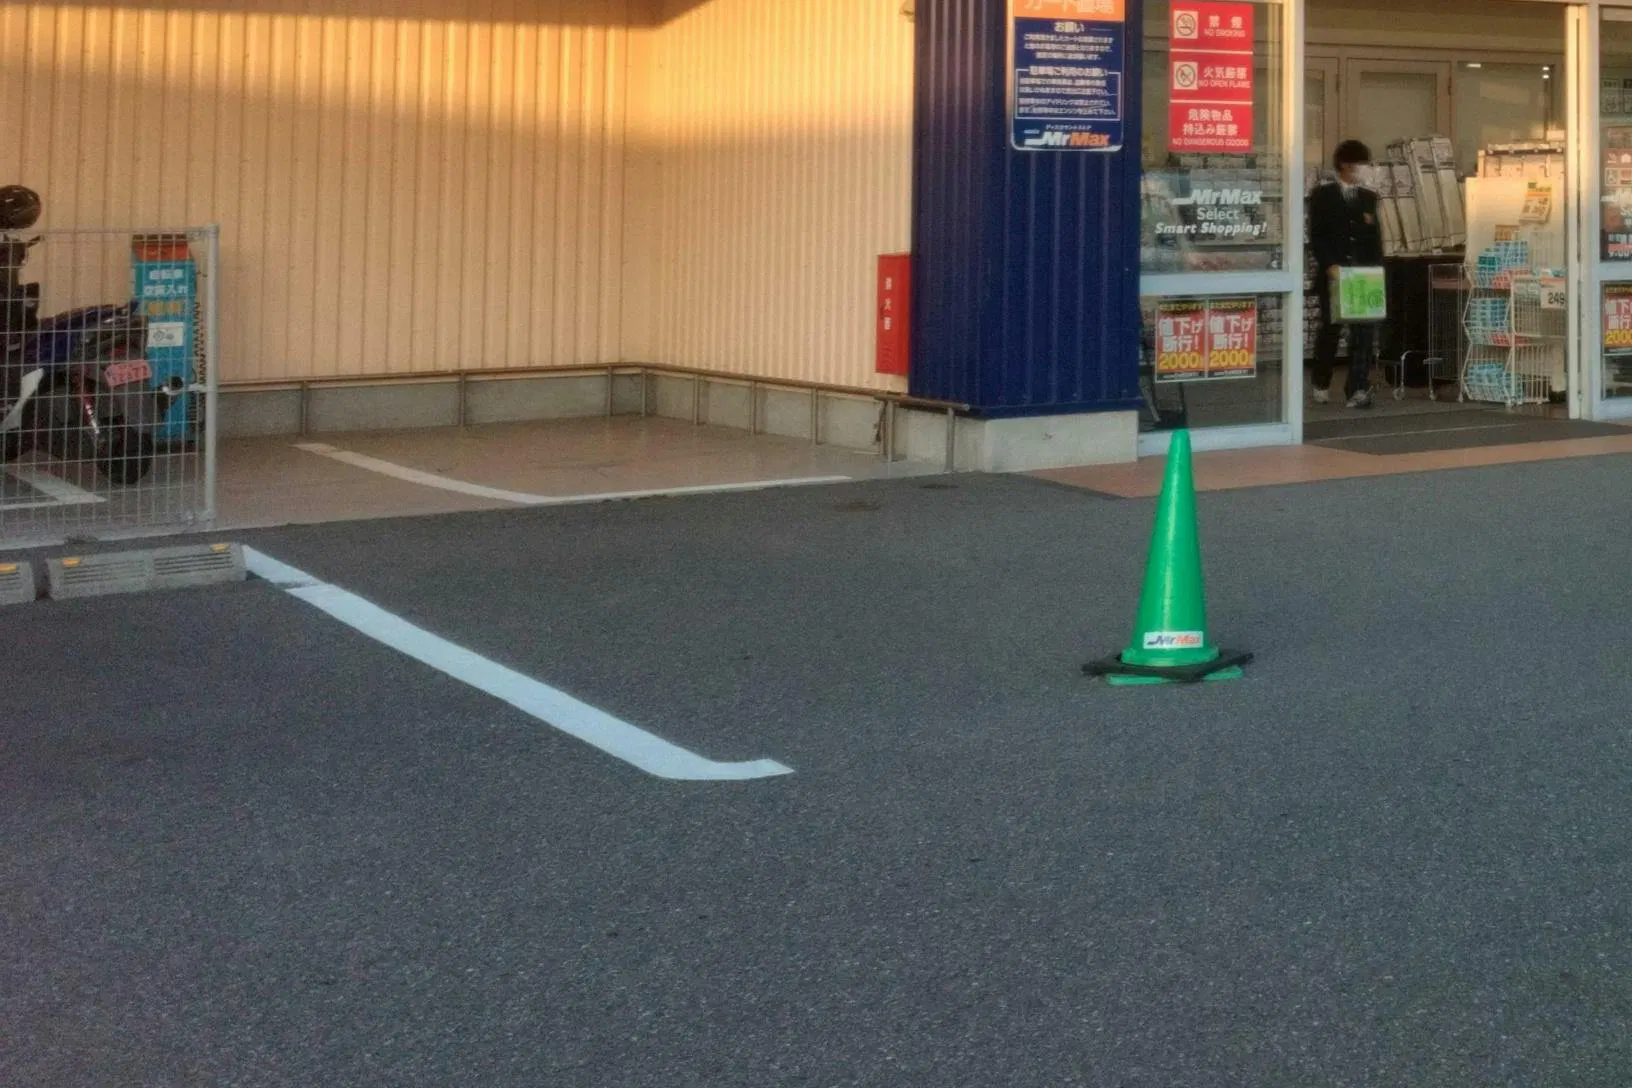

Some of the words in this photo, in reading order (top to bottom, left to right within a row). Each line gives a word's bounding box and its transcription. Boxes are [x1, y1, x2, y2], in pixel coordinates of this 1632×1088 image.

[1023, 131, 1110, 147] MrMax
[1172, 188, 1262, 205] MrMax
[1197, 207, 1241, 220] Select
[1155, 222, 1198, 234] Smart
[1201, 221, 1267, 236] Shopping!
